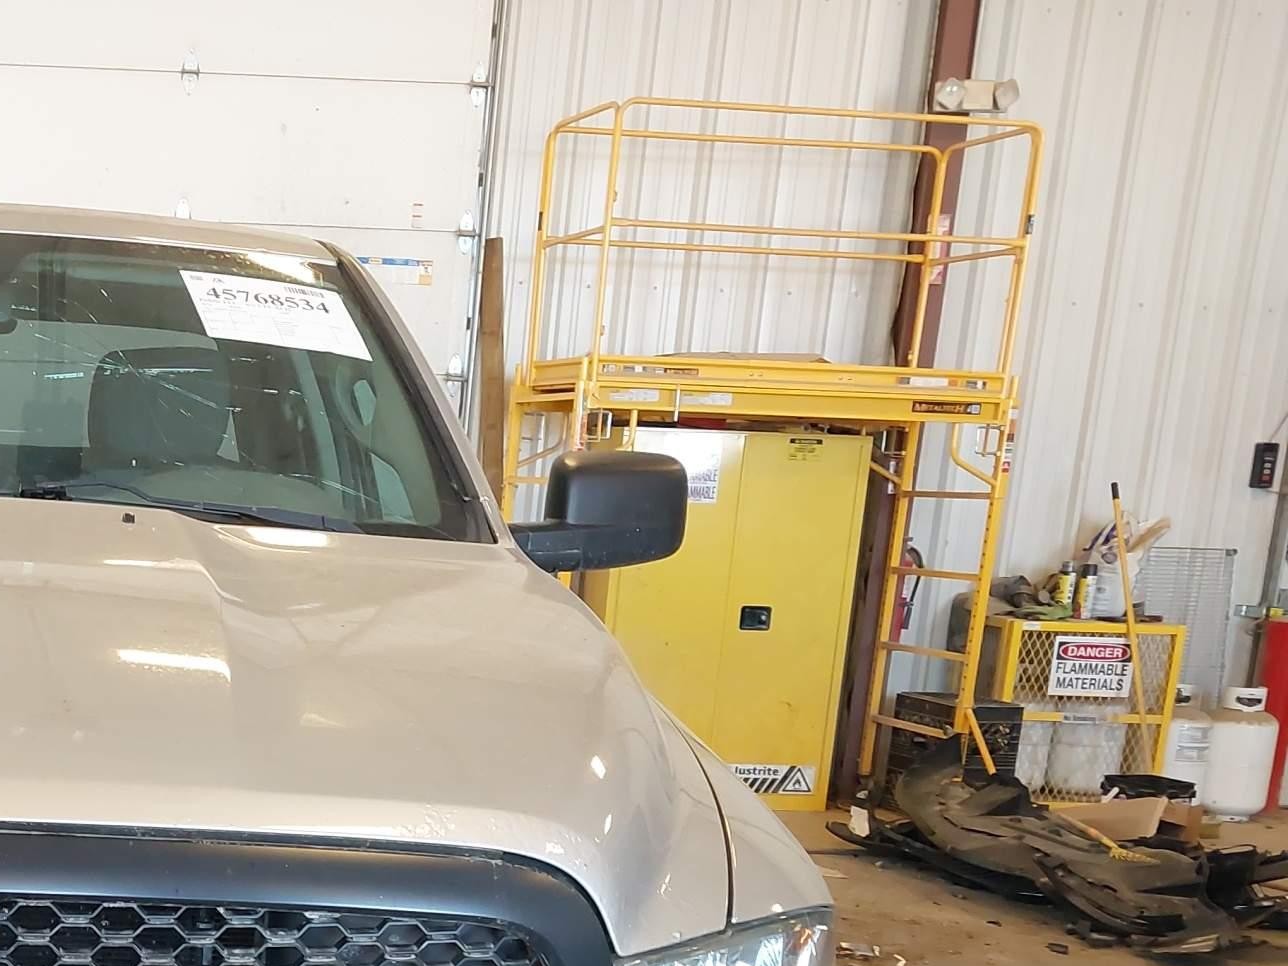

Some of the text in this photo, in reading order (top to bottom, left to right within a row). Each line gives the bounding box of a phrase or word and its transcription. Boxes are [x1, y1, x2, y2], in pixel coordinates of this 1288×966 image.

[206, 287, 330, 314] 45768534
[1067, 646, 1124, 658] DANGER
[1055, 662, 1129, 676] FLAMMABLE
[1055, 677, 1124, 691] MATERIALS
